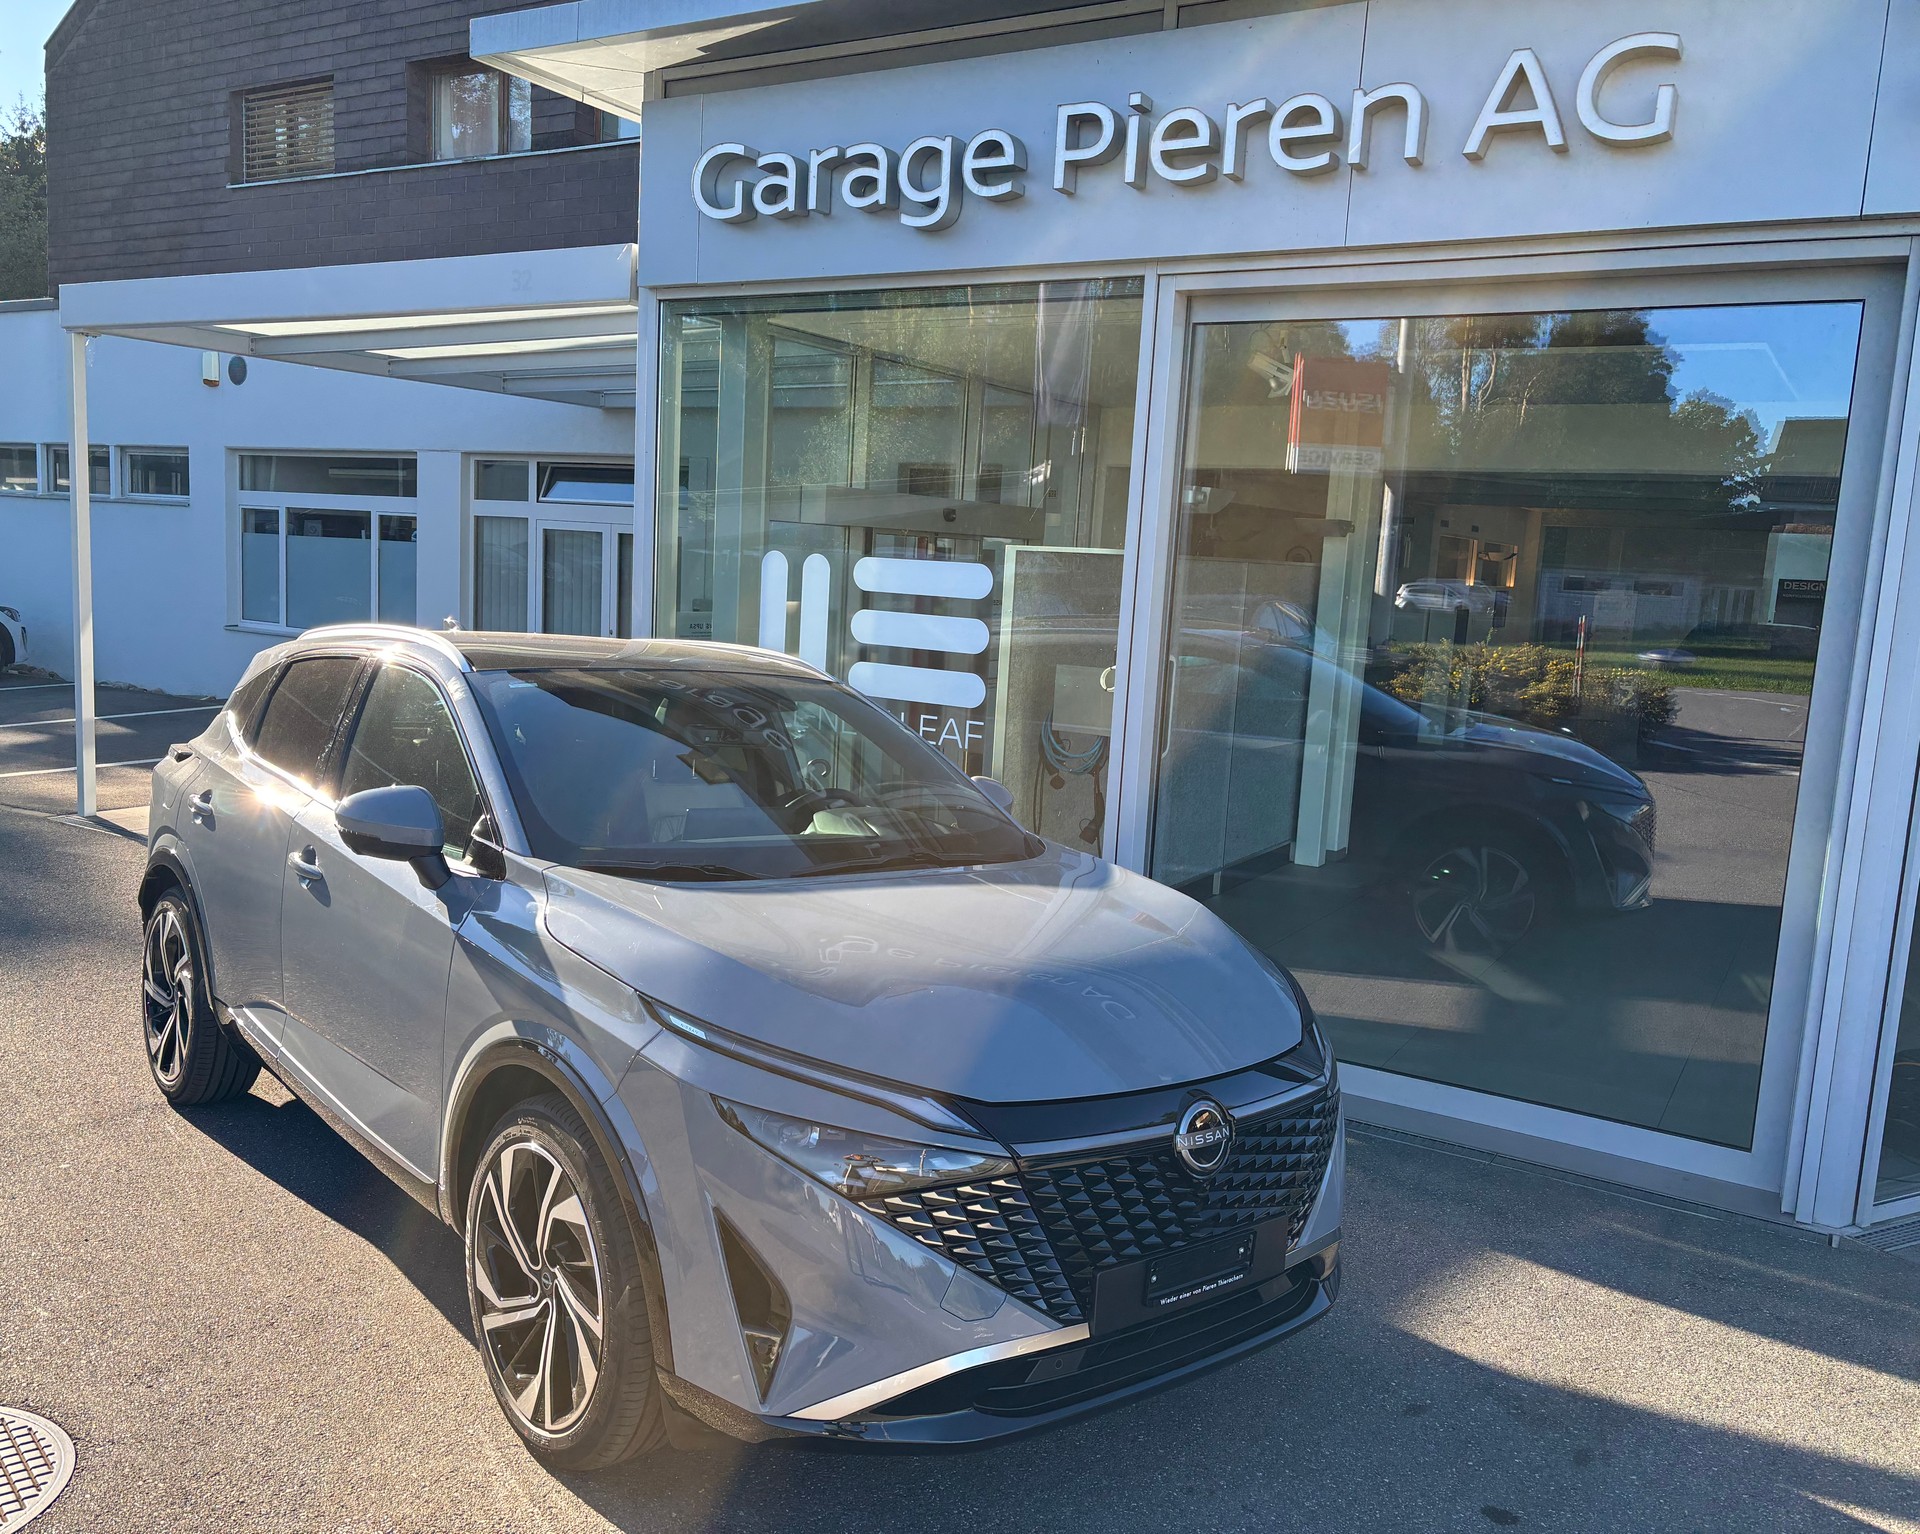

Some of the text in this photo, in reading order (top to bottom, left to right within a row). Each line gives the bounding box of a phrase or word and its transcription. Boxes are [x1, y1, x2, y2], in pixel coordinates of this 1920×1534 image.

[691, 31, 1683, 232] Garage Pieren AG
[900, 711, 985, 750] EAF
[1176, 1125, 1230, 1148] NISSAN
[1160, 1294, 1179, 1306] Wieder
[1179, 1290, 1192, 1300] einer
[1202, 1282, 1217, 1292] Pieren
